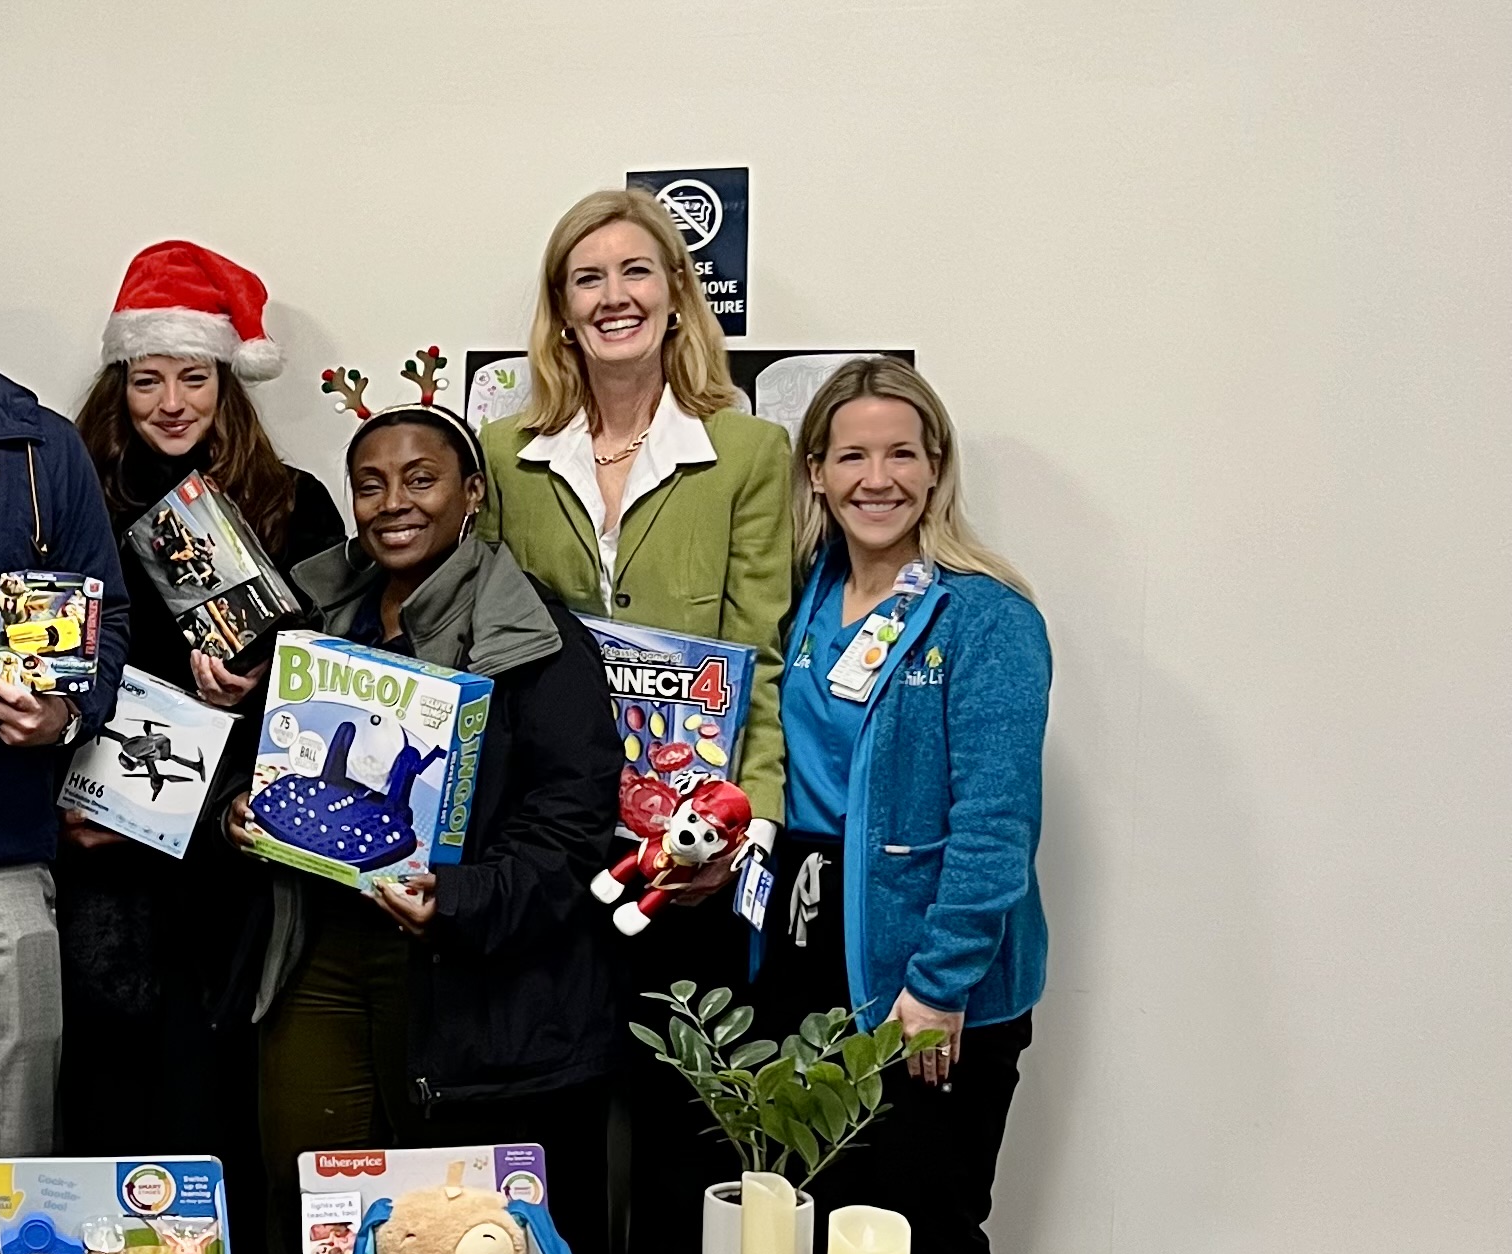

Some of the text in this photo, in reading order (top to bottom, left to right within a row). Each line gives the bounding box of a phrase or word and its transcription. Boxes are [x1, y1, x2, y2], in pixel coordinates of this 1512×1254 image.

[277, 645, 419, 721] BINGO!
[279, 715, 292, 731] 75
[439, 694, 490, 846] BINGO!
[68, 771, 105, 798] HK66
[319, 1155, 383, 1170] fisher-price
